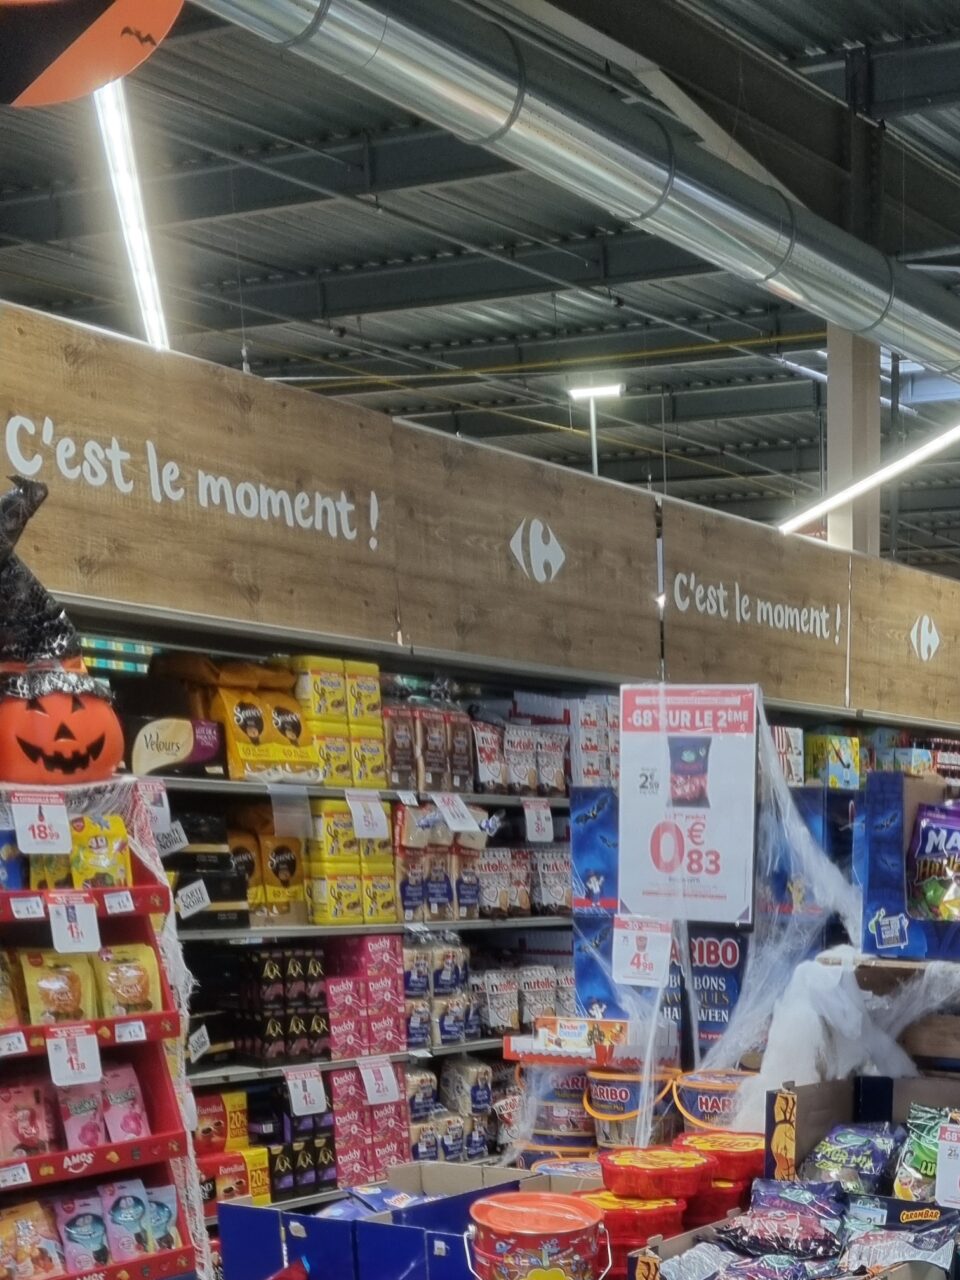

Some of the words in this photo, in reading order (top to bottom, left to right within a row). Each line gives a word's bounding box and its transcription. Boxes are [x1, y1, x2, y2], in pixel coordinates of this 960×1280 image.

[6, 414, 133, 492] C'est
[147, 441, 184, 502] le
[198, 470, 357, 539] moment
[369, 491, 379, 550] !
[673, 572, 729, 619] C'est
[734, 582, 751, 622] le
[757, 601, 830, 640] moment
[834, 604, 841, 645] !
[695, 711, 712, 727] LE
[144, 732, 182, 752] Velours
[367, 937, 390, 953] Daddy
[329, 978, 353, 995] Daddy
[368, 977, 391, 992] Daddy
[330, 1020, 355, 1035] Daddy
[370, 1016, 393, 1032] Daddy
[333, 1071, 356, 1086] Daddy
[336, 1110, 358, 1125] Daddy
[373, 1104, 396, 1119] Daddy
[337, 1149, 360, 1164] Daddy
[375, 1142, 398, 1157] Daddy
[63, 1151, 94, 1168] AMOS
[219, 1162, 245, 1175] Familial
[900, 1209, 941, 1223] CARAMBAR
